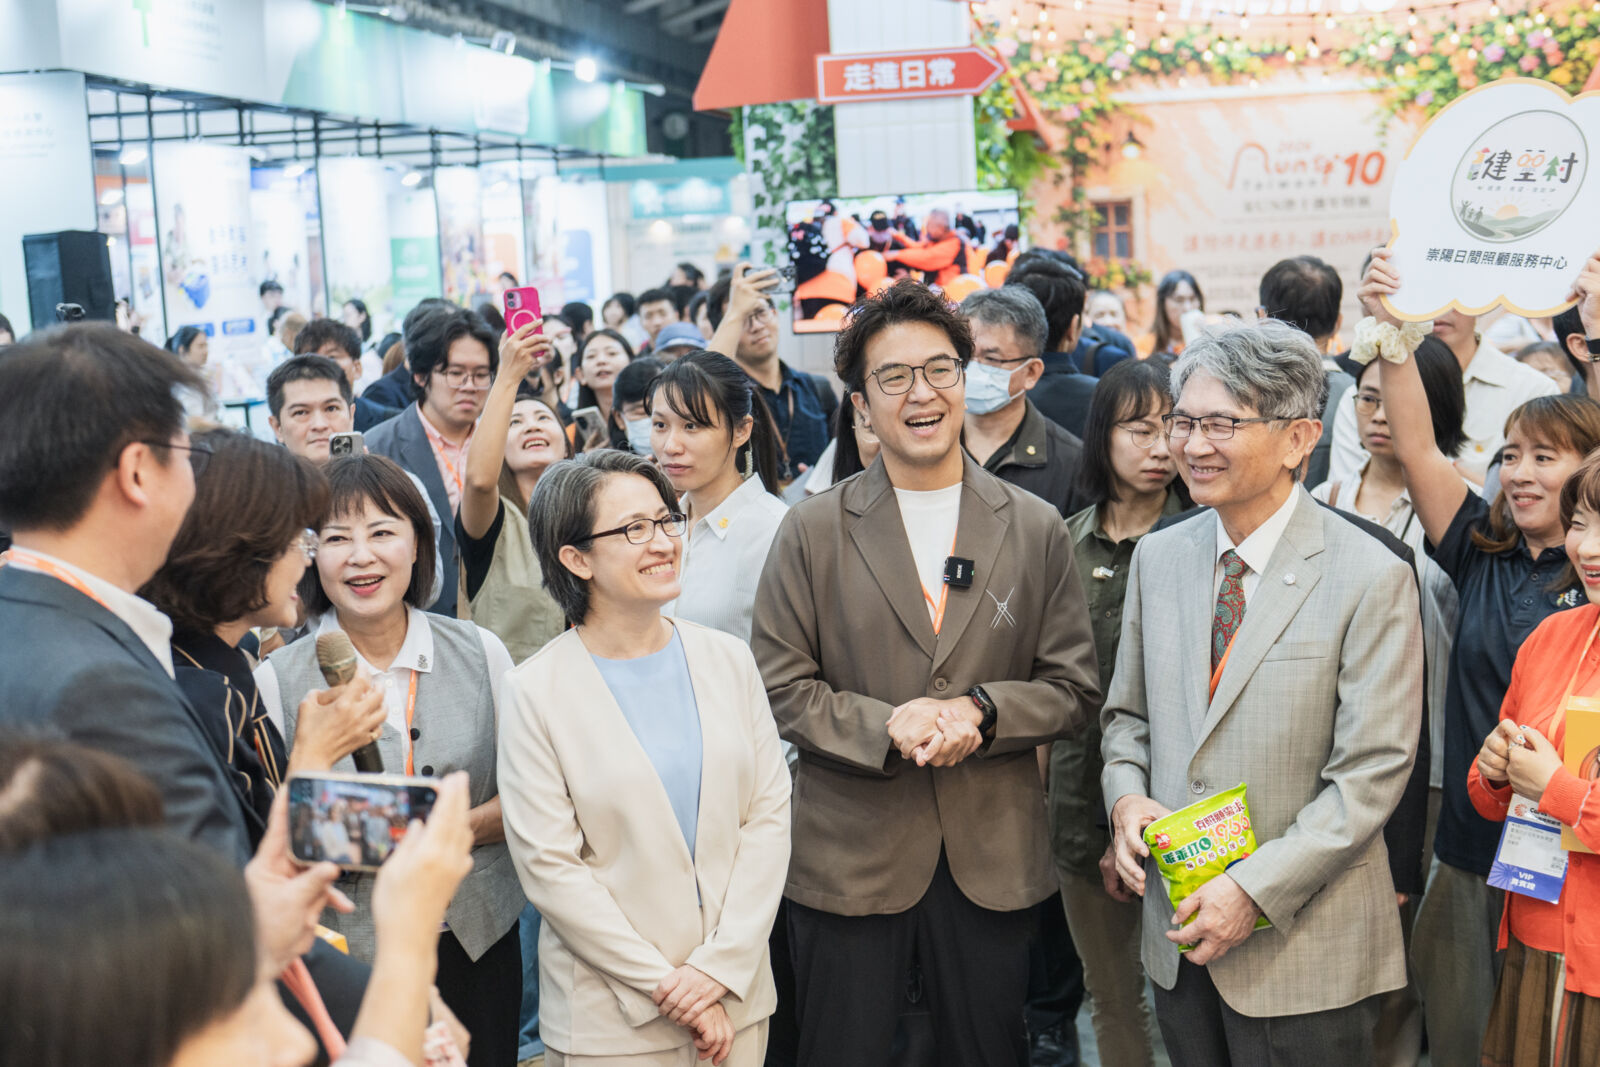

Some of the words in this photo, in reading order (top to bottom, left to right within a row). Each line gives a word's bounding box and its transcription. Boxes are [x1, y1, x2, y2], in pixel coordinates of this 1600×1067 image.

[844, 57, 956, 92] 走進日常
[1427, 247, 1568, 269] 崇陽日間照顧服務中心
[1207, 814, 1250, 845] 1966
[1518, 871, 1535, 881] VIP
